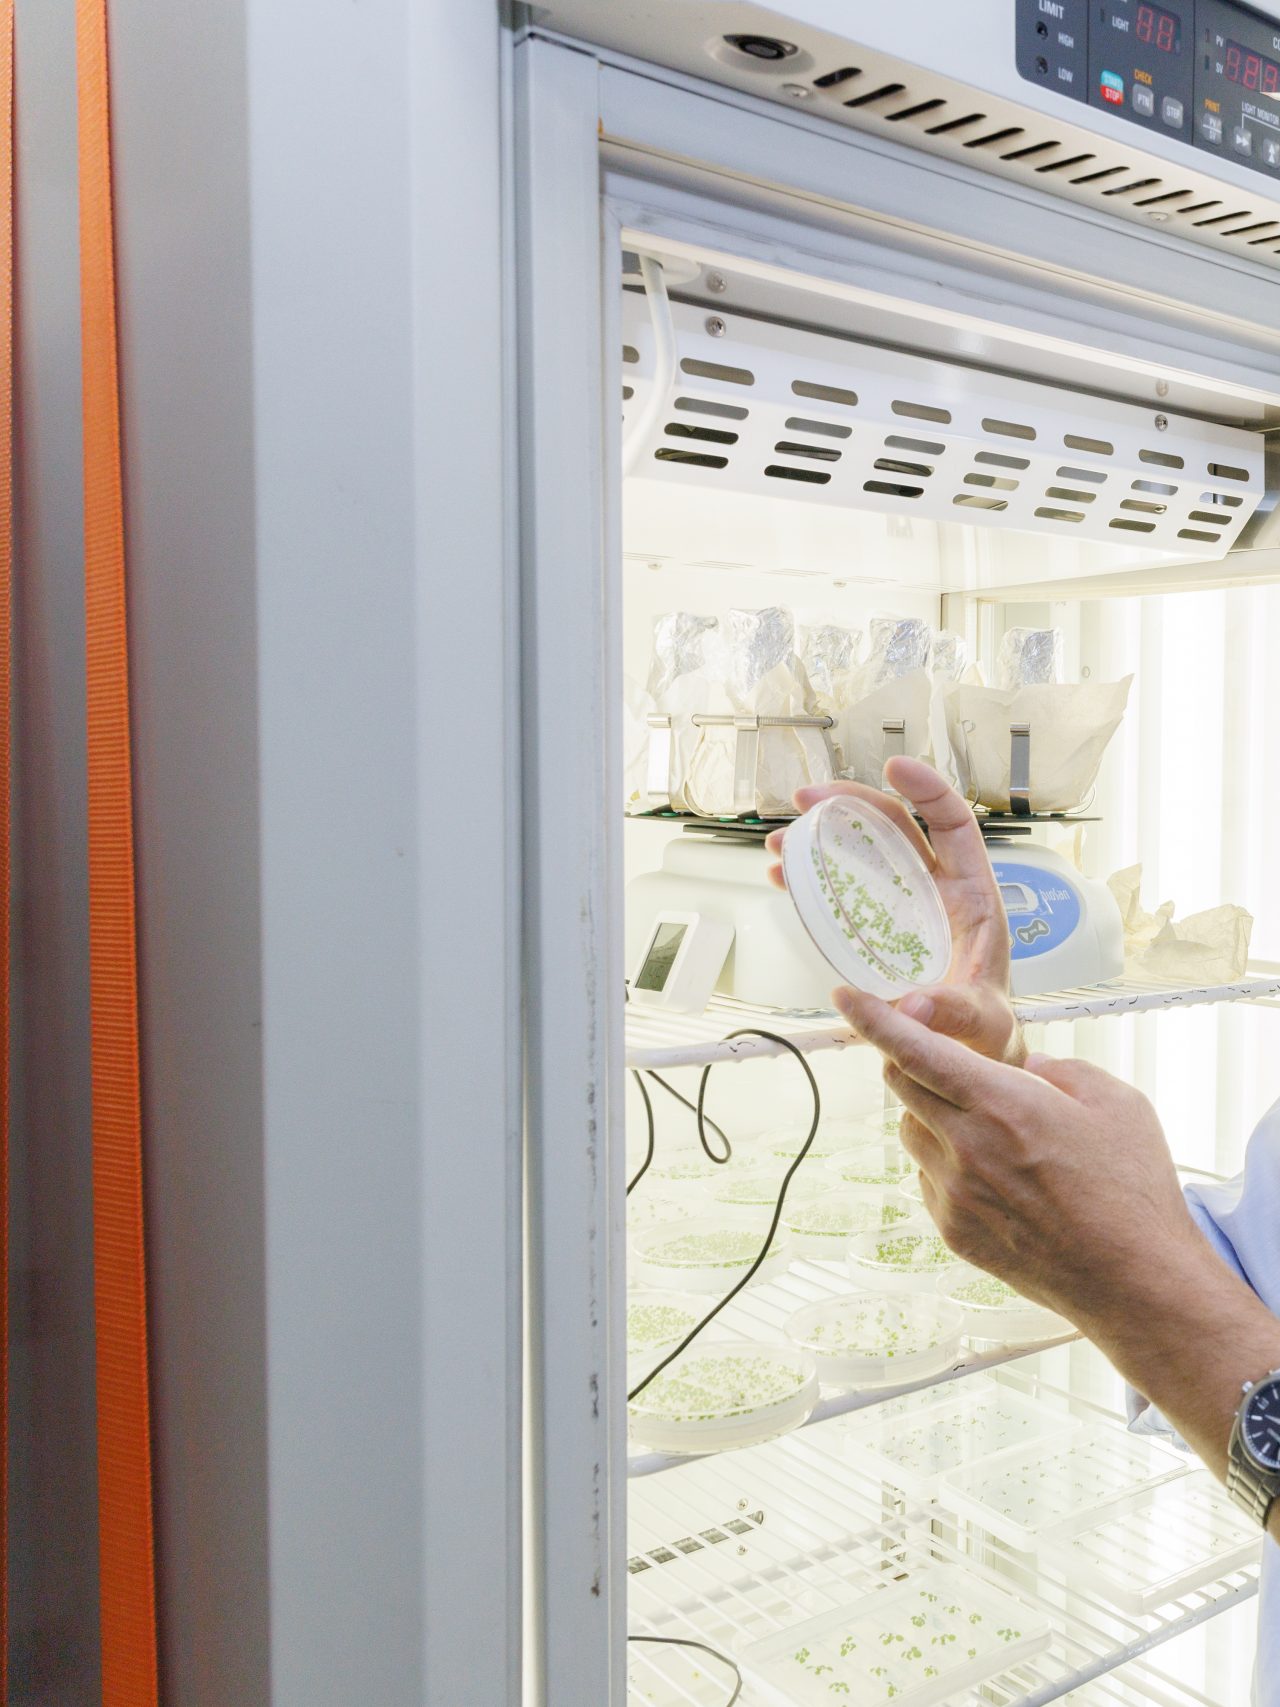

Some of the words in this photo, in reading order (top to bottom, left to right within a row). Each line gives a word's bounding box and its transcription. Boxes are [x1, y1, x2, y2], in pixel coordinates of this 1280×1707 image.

[1039, 0, 1064, 19] LIMIT
[1112, 16, 1129, 32] LIGHT
[1058, 32, 1074, 48] HIGH
[1216, 35, 1224, 47] PV
[1058, 67, 1073, 83] LOW
[1134, 68, 1153, 86] CHECK
[1105, 87, 1121, 102] STOP
[1166, 105, 1180, 119] STEP
[1241, 101, 1256, 115] LIGHT
[1257, 107, 1280, 126] MONITOR
